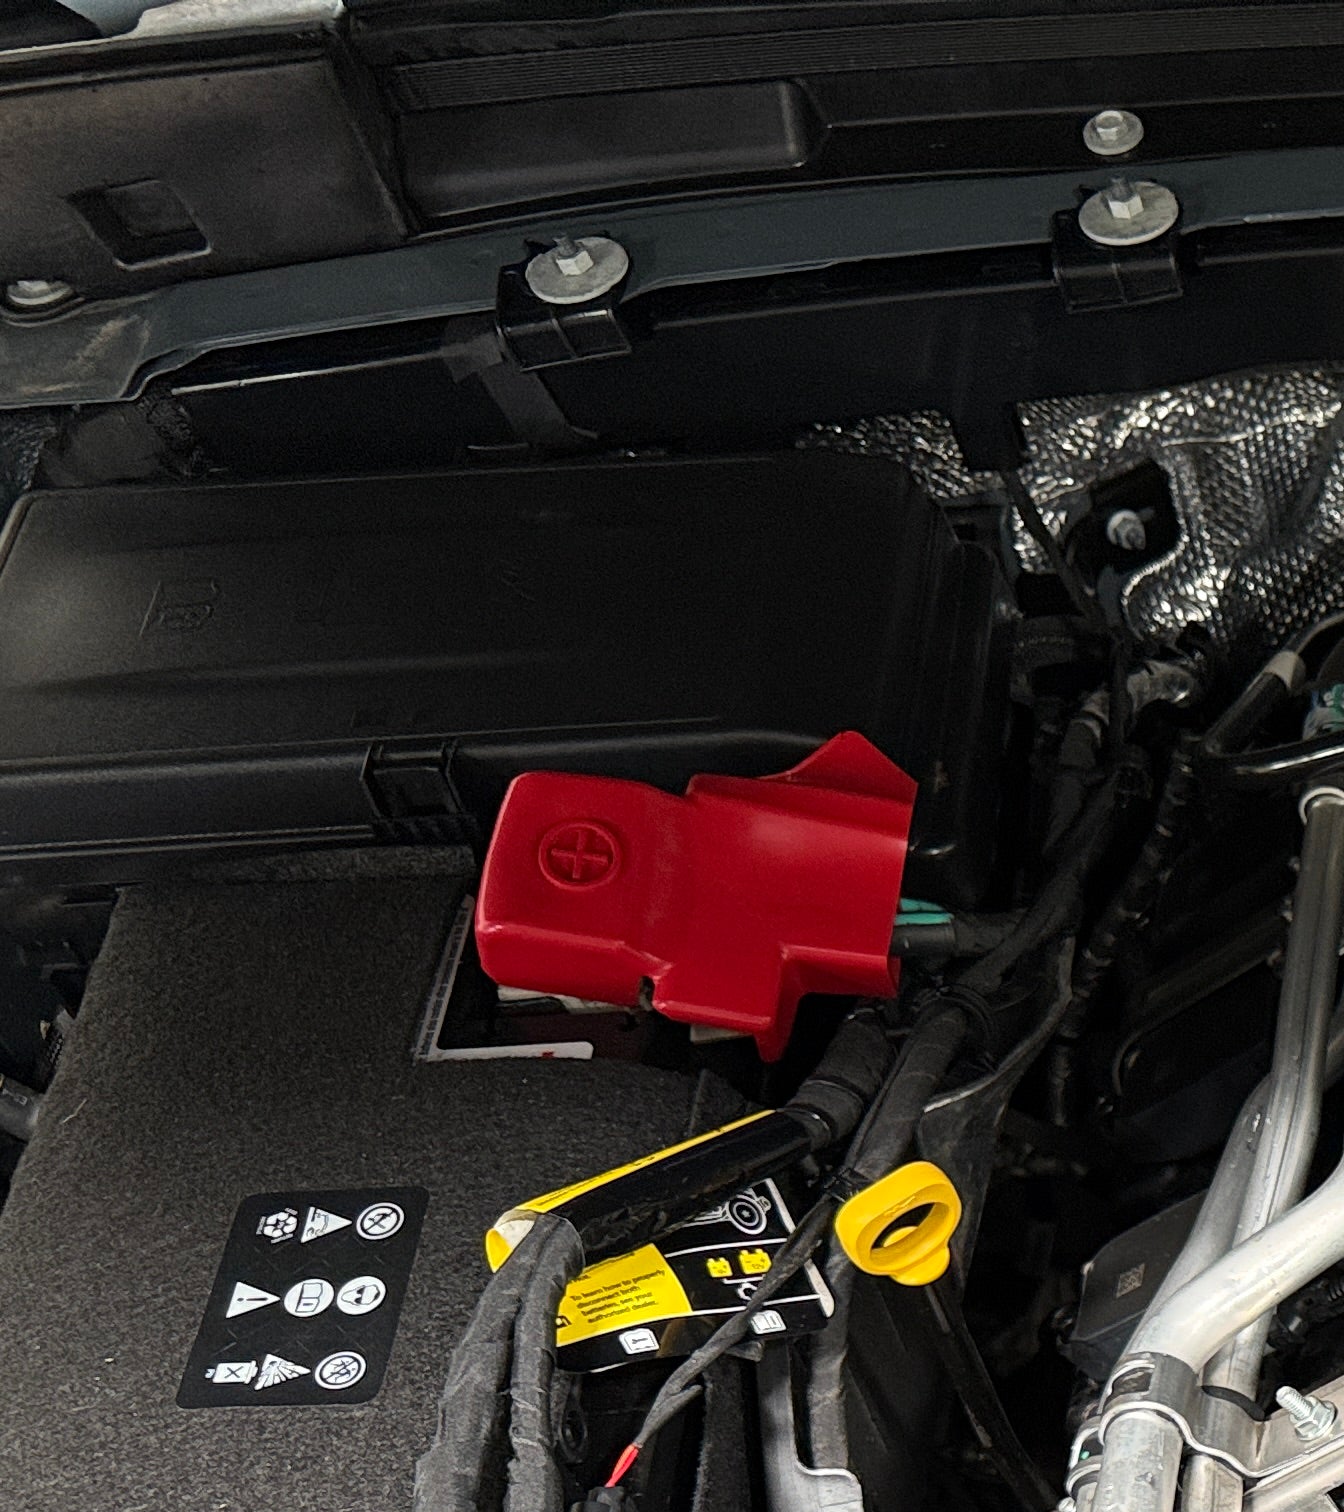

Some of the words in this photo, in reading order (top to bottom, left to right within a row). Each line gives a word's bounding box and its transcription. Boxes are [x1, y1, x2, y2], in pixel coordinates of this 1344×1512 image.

[581, 1289, 603, 1297] learn
[603, 1283, 622, 1291] how
[632, 1270, 665, 1283] properly
[577, 1292, 620, 1308] disconnect
[620, 1286, 640, 1295] both
[635, 1292, 652, 1301] your
[588, 1307, 631, 1323] authorized
